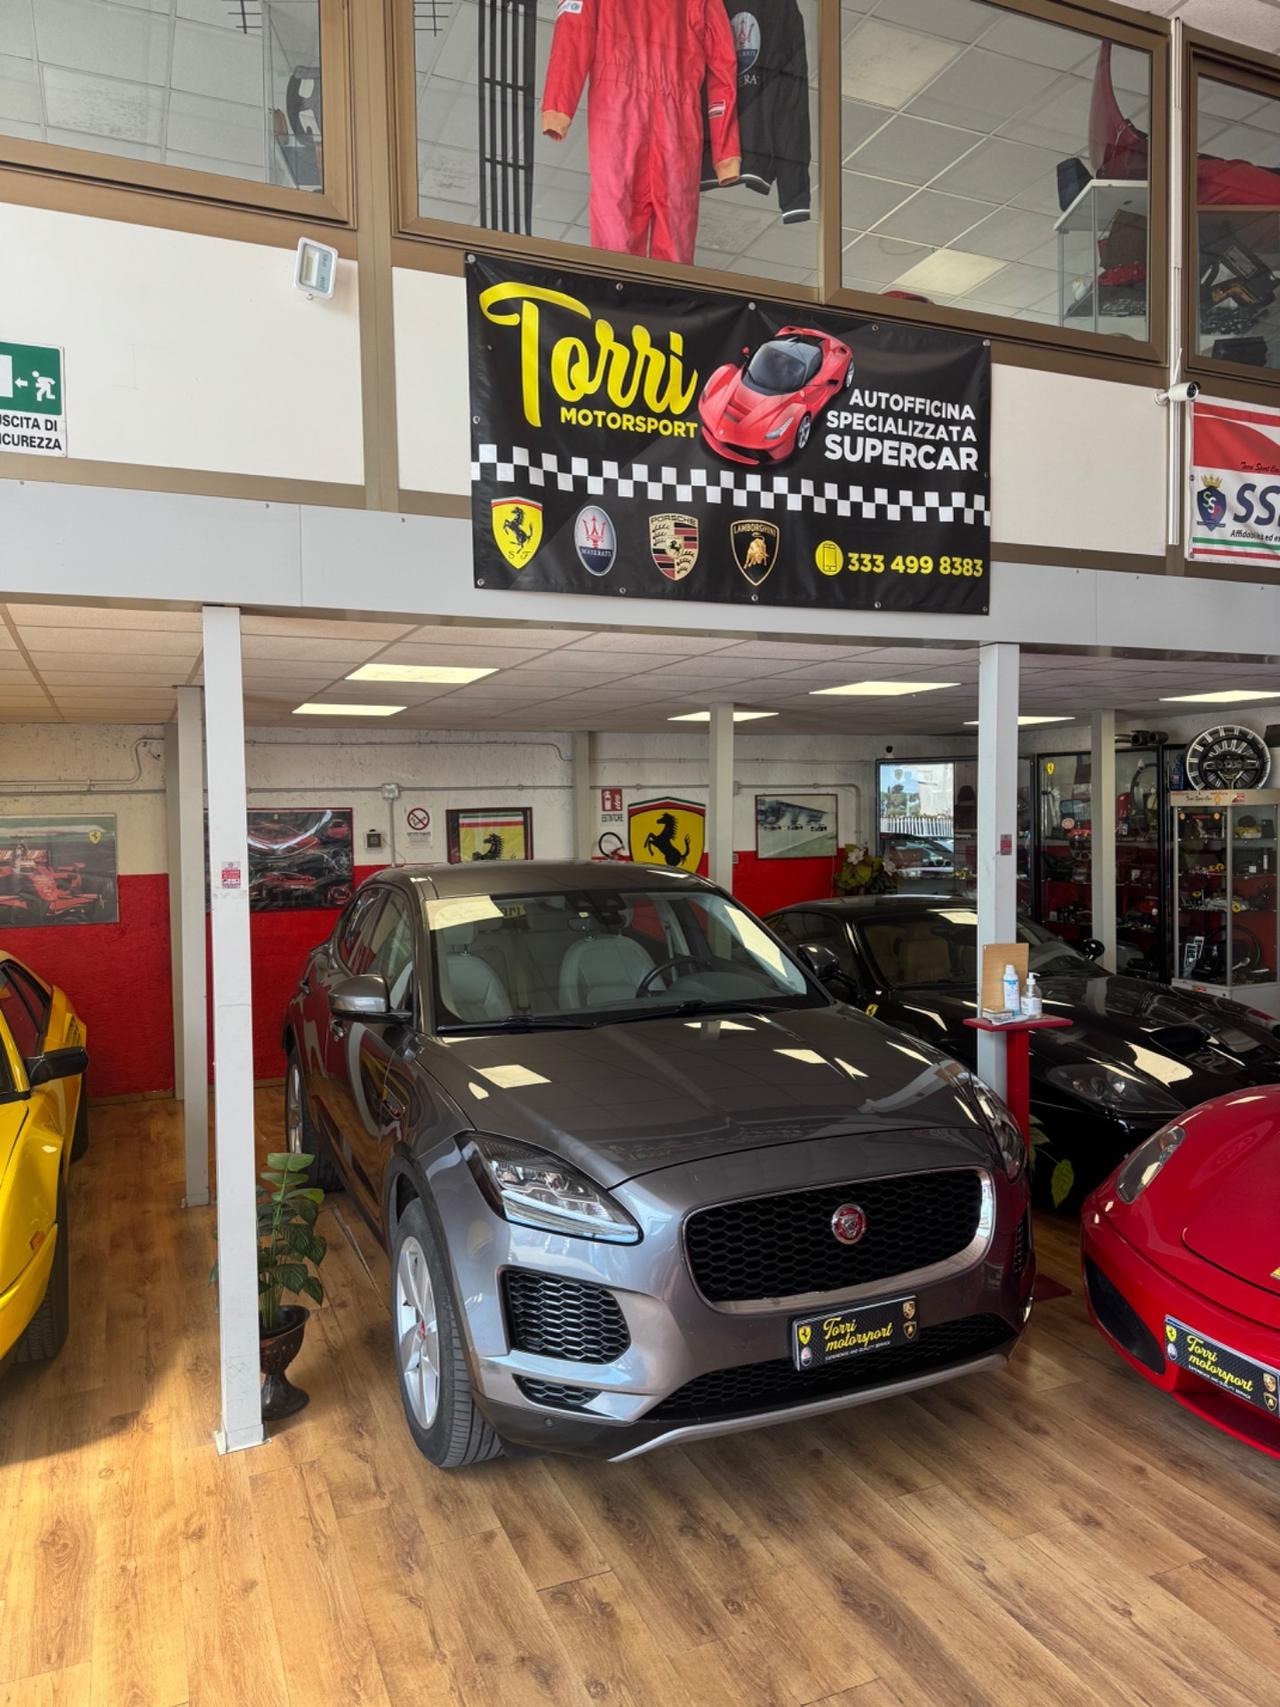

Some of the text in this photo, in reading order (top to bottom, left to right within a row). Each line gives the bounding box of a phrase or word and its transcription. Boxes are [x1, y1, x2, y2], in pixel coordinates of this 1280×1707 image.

[479, 281, 698, 427] Torri
[849, 388, 976, 420] AUTOFFICINA
[44, 419, 58, 432] DI
[560, 407, 698, 438] MOTORSPORT
[826, 410, 977, 442] SPECIALIZZATA
[824, 433, 979, 471] SUPERCAR
[650, 513, 697, 526] PORSCHE
[733, 522, 776, 537] LAMBORGHINI
[847, 552, 983, 577] 333 499 8383
[823, 1317, 856, 1339] Torri
[826, 1322, 893, 1351] motorsport
[1186, 1335, 1218, 1362] Torri
[1188, 1354, 1253, 1392] motorsport
